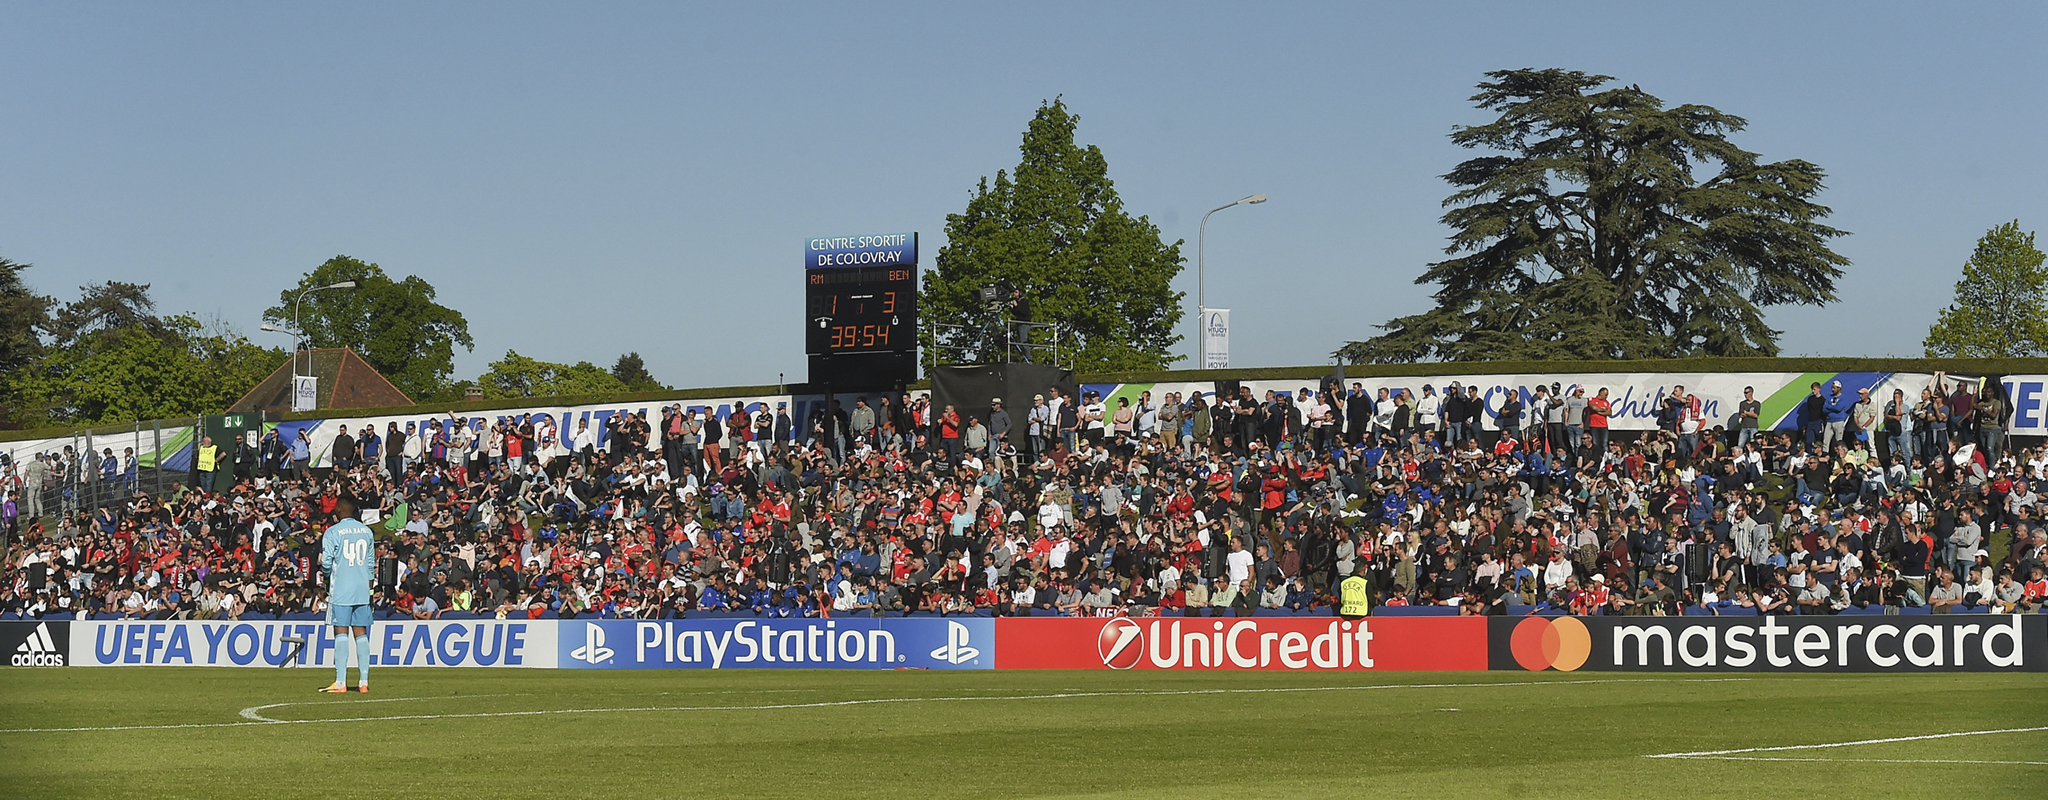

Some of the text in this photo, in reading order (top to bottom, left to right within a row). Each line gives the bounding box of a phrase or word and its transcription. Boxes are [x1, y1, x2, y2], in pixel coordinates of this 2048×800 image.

[810, 234, 906, 250] CENTRE SPORTIF
[818, 250, 902, 266] DE COLOVRAY
[810, 274, 824, 284] RM
[889, 270, 910, 281] BEN
[832, 295, 837, 315] 1
[883, 291, 896, 313] 3
[830, 324, 890, 348] 39:54
[1608, 385, 1719, 419] chiln
[343, 538, 367, 567] 40
[94, 624, 193, 664] UEFA
[636, 620, 895, 668] PlayStation
[1150, 620, 1374, 668] UniCredit
[1613, 615, 2023, 667] mastercard
[11, 651, 64, 667] adidas
